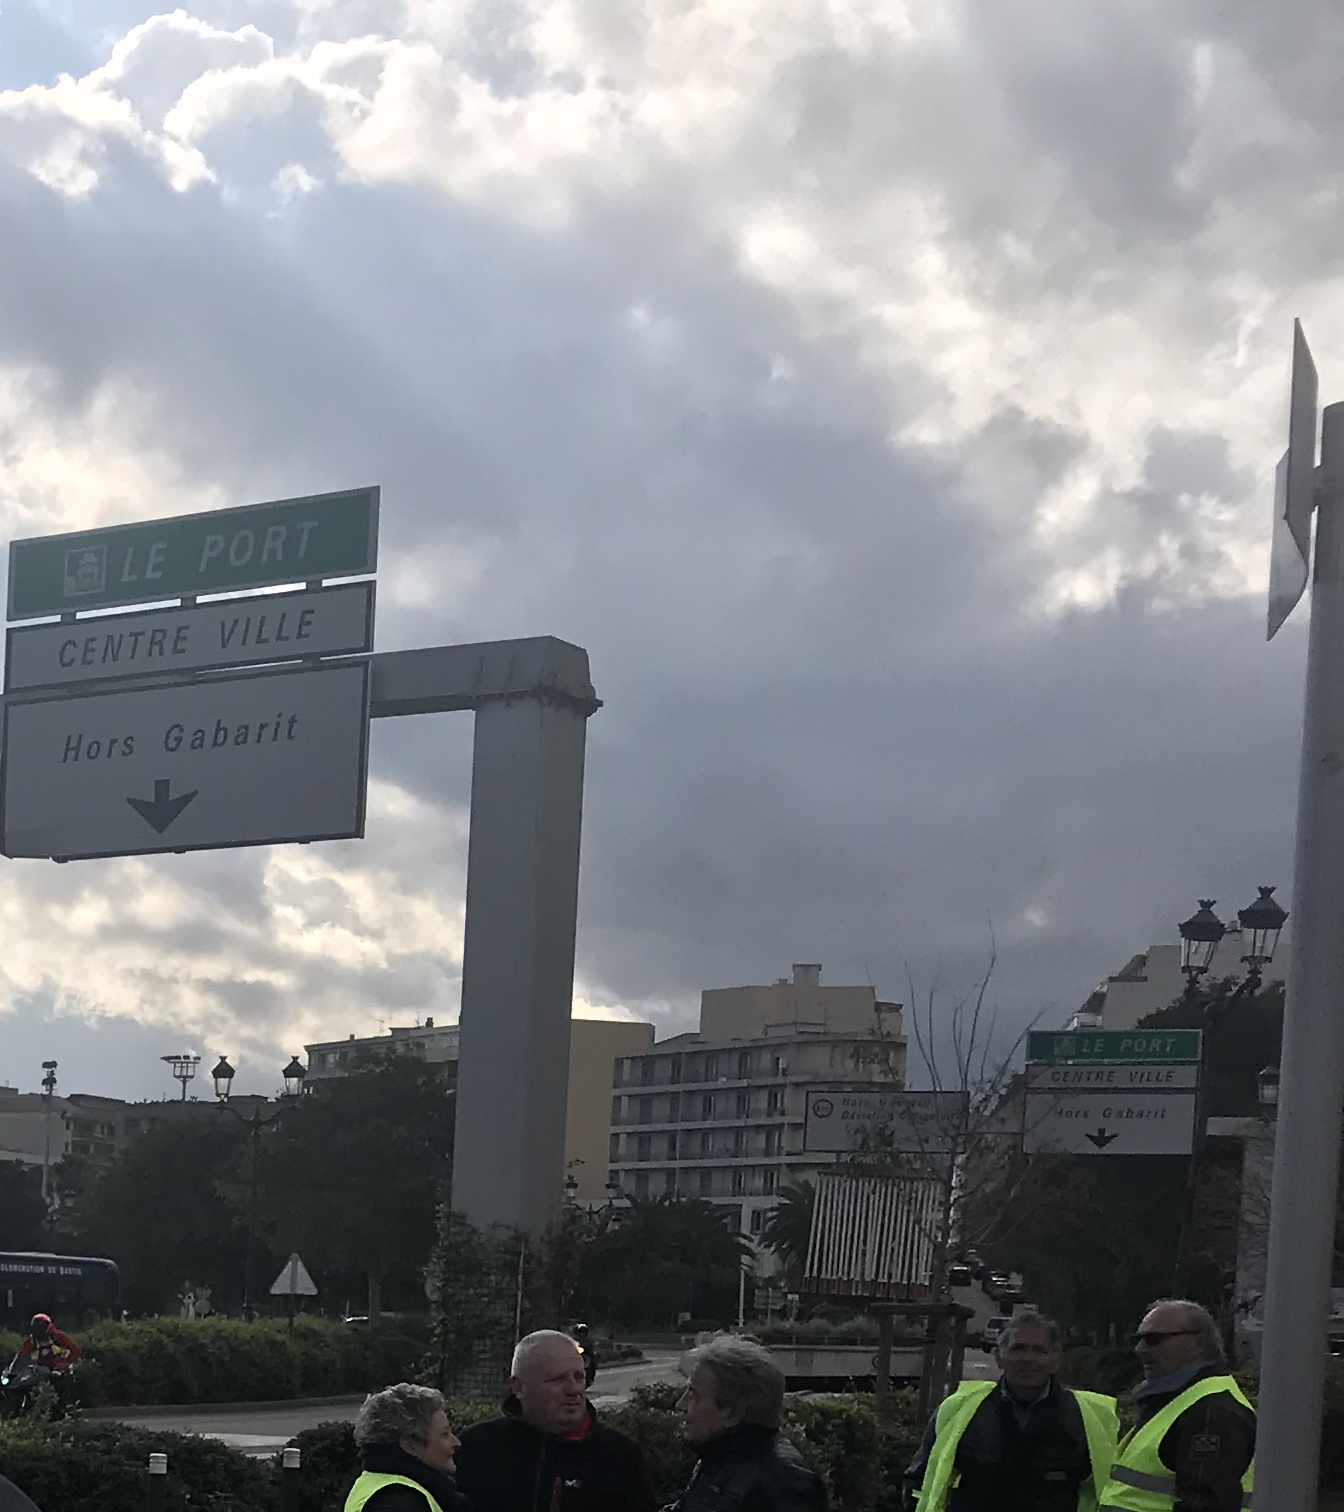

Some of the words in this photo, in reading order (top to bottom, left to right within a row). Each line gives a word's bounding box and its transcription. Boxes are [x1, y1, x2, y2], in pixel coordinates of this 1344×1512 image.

[121, 541, 168, 584] LE
[199, 520, 320, 573] PORT
[58, 624, 192, 669] CENTRE
[219, 608, 316, 650] VILLE
[62, 733, 135, 764] Hors
[163, 711, 299, 753] Gabarit
[1081, 1037, 1105, 1054] LE
[1119, 1037, 1178, 1053] PORT
[1050, 1070, 1116, 1083] CENTRE
[1128, 1070, 1177, 1084] VILLE
[1102, 1106, 1168, 1120] Gabarit
